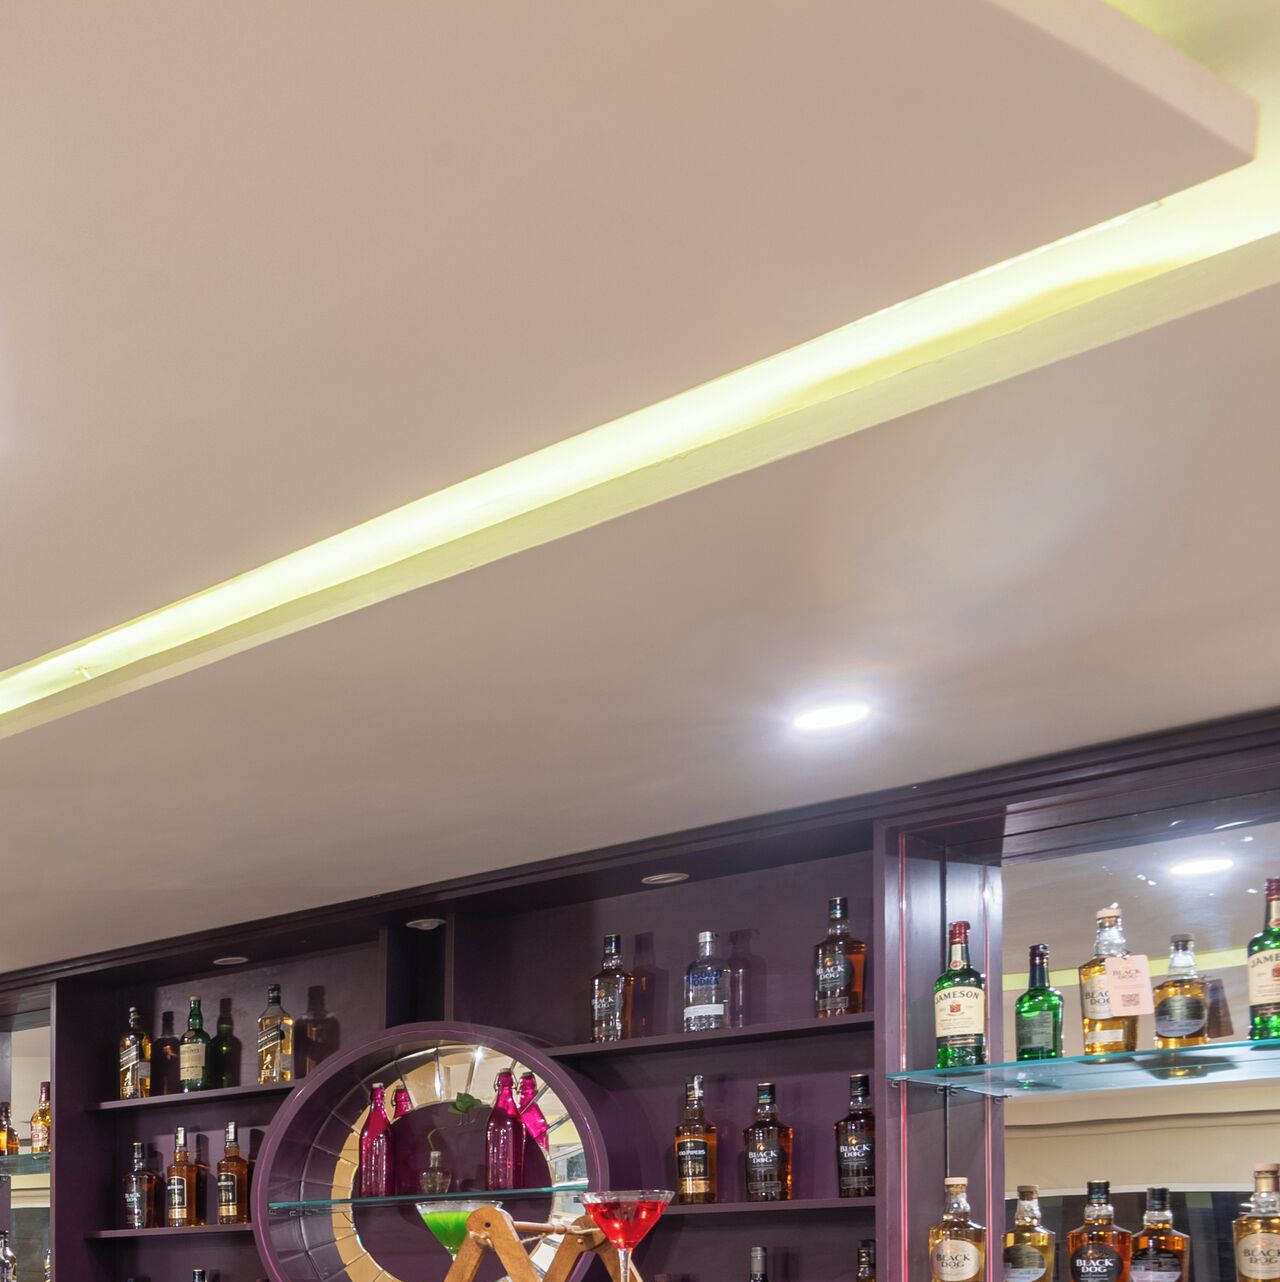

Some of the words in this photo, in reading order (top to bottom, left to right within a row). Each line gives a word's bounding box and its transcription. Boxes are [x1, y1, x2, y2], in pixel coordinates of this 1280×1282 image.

[815, 965, 845, 976] BLACK
[819, 972, 840, 981] DOG
[935, 989, 980, 1005] JAMESON
[1085, 991, 1110, 1000] BLAC
[839, 1143, 872, 1153] BLACK
[748, 1149, 778, 1159] BLACK
[752, 1156, 773, 1164] DOG
[936, 1252, 971, 1262] BLACK
[1249, 1256, 1278, 1265] DOG
[941, 1260, 965, 1269] DOG
[1075, 1259, 1114, 1267] BLACK
